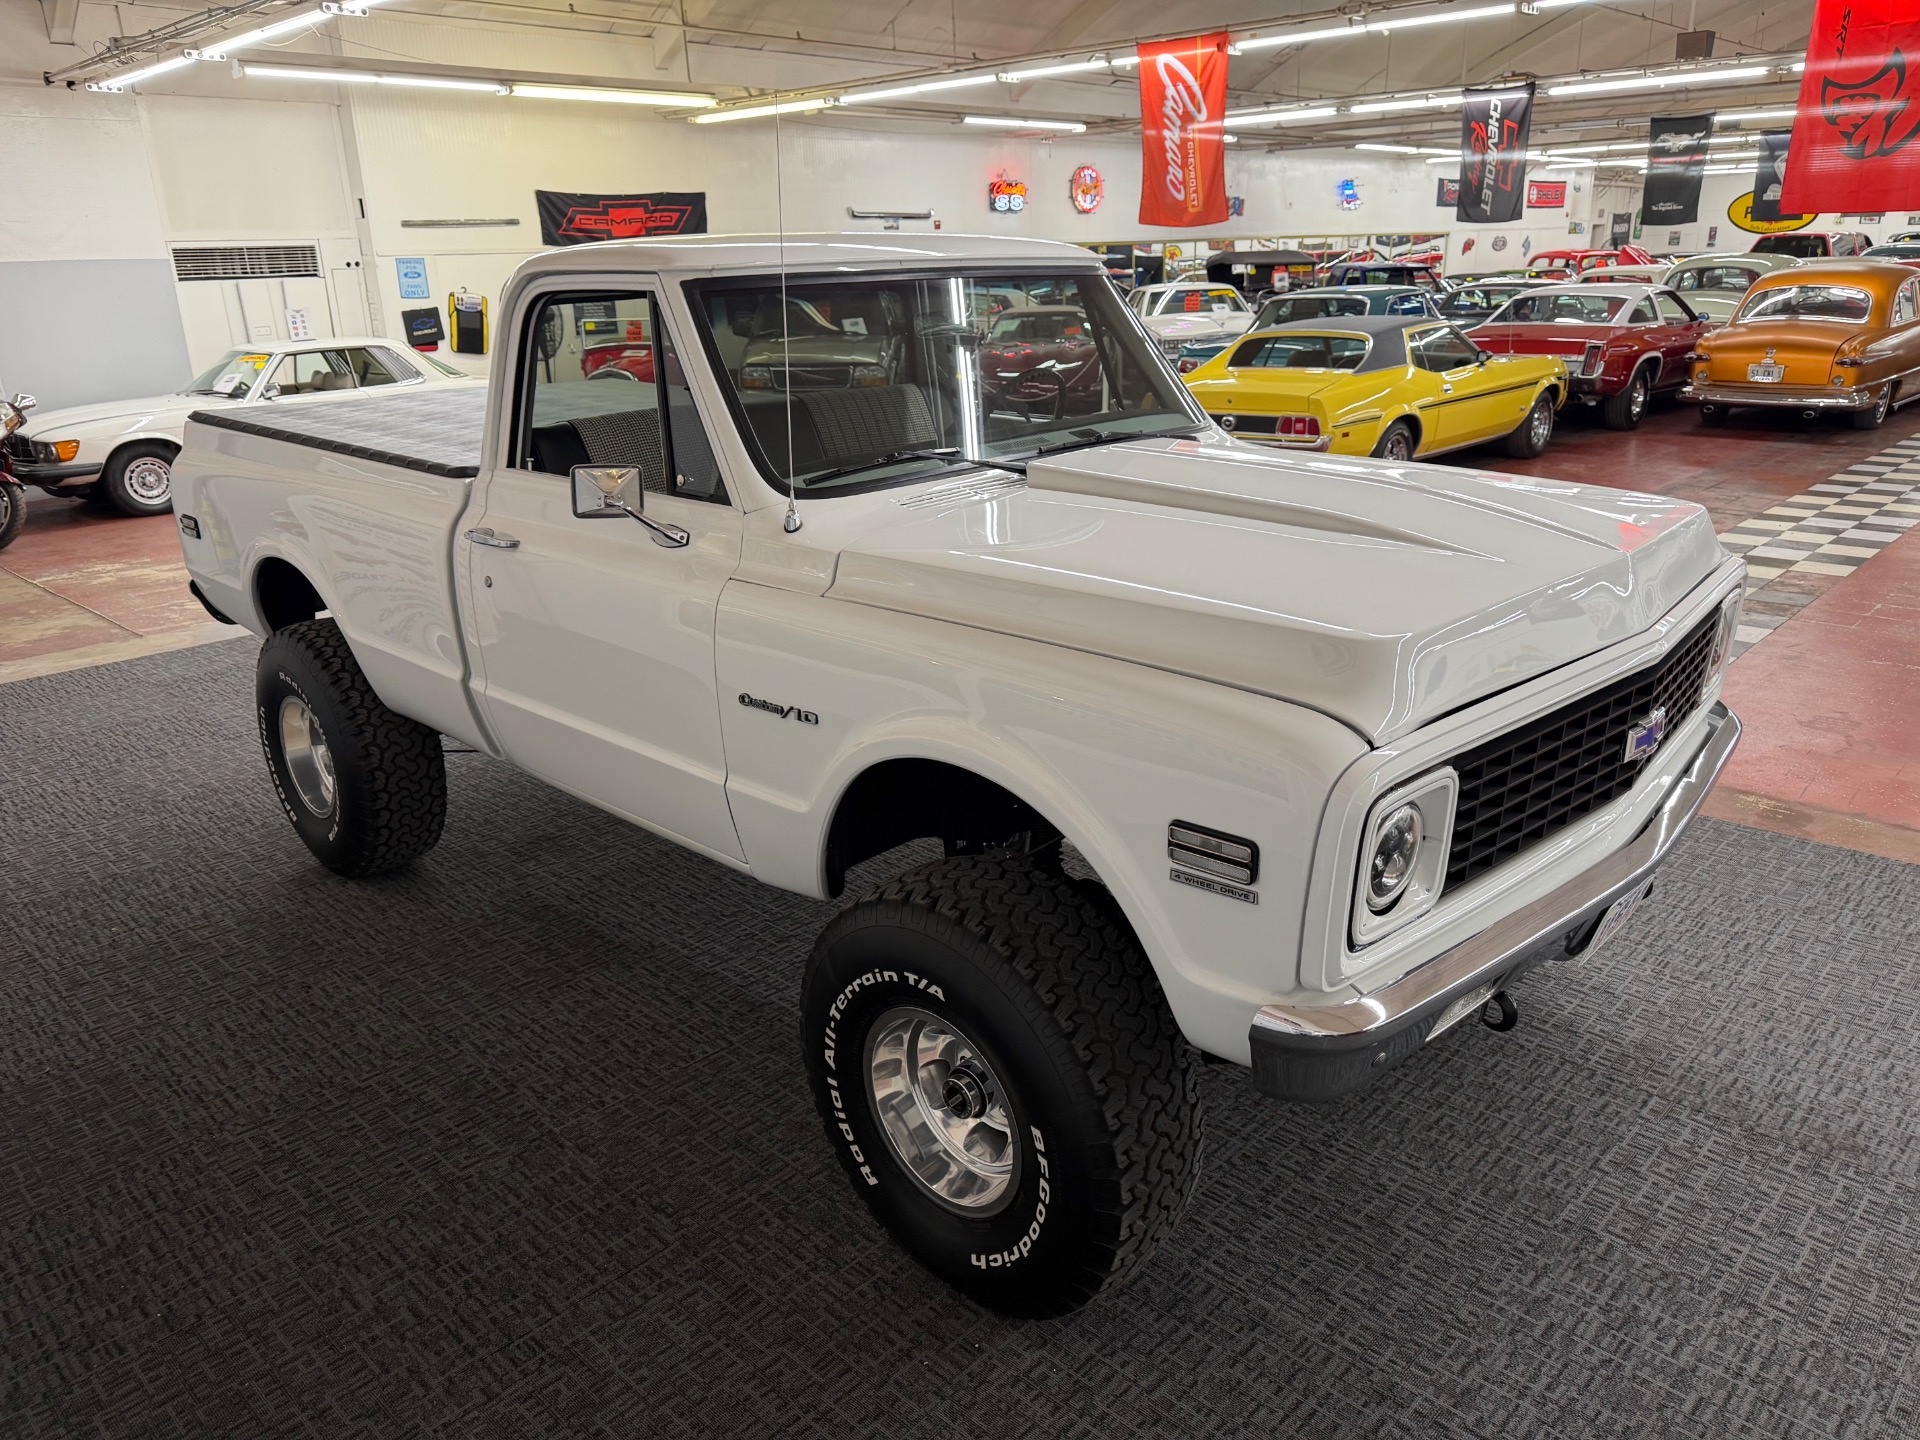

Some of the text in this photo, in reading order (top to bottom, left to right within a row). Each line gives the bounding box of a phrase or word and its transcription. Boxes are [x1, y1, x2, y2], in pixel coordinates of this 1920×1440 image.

[1156, 53, 1207, 201] Camaro
[1481, 99, 1501, 216] CHEVROLET
[994, 194, 1024, 211] SS
[1187, 143, 1198, 207] CHEVROLET
[1537, 189, 1563, 200] SHELBY
[578, 215, 673, 227] CAMARO
[1184, 876, 1218, 891] WHEEL
[1220, 886, 1250, 900] DRIVE
[824, 968, 946, 1186] Radial All-Terrain T/A
[970, 1125, 1050, 1270] BFGoodrich
